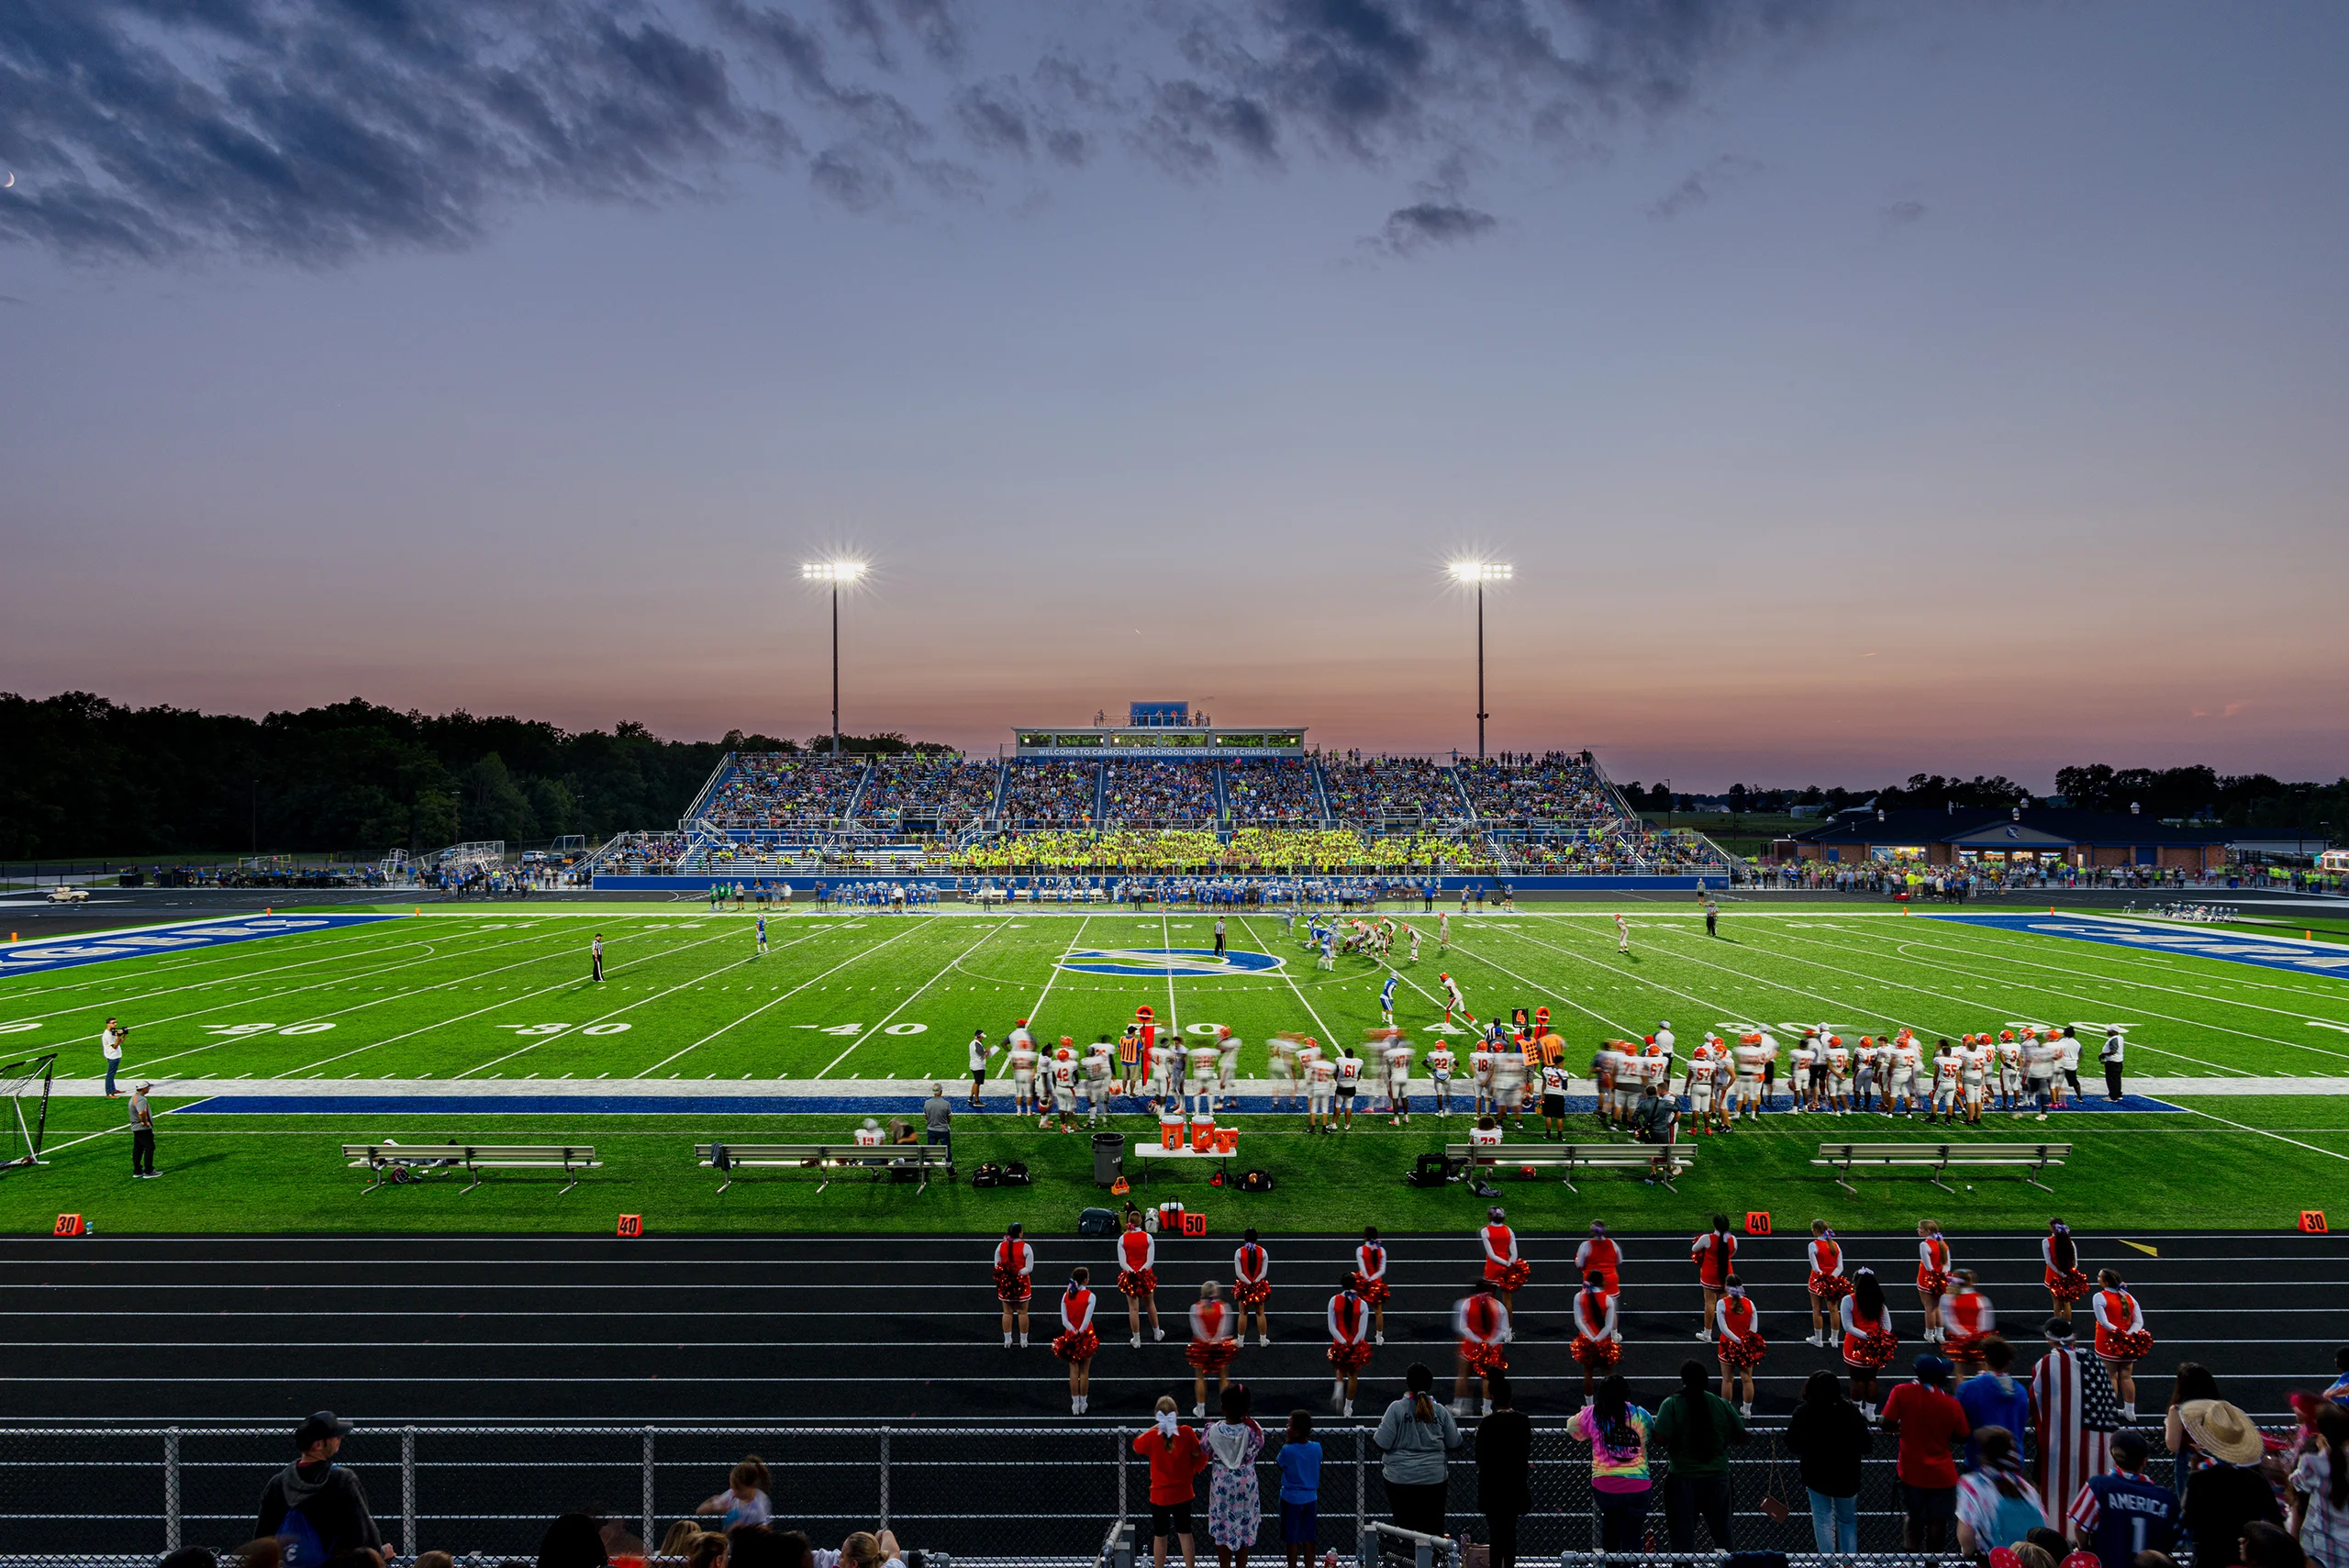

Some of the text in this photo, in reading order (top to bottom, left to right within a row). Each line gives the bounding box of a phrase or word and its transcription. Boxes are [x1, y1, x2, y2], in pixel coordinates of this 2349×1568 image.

[0, 919, 329, 971] GERS
[1516, 1010, 1525, 1024] 4
[516, 1023, 631, 1035] 30
[820, 1023, 928, 1035] 40
[1434, 1058, 1447, 1069] 22
[1478, 1059, 1488, 1072] 18
[1836, 1055, 1845, 1068] 51
[1057, 1068, 1069, 1082] 42
[1344, 1064, 1356, 1078] 61
[1650, 1063, 1664, 1077] 67
[1698, 1068, 1710, 1081] 57
[1943, 1063, 1957, 1077] 55
[1547, 1074, 1561, 1087] 32
[57, 1216, 76, 1233] 30
[620, 1217, 638, 1233] 40
[1186, 1216, 1203, 1233] 50
[1752, 1215, 1768, 1231] 40
[2305, 1214, 2325, 1229] 30
[2110, 1493, 2168, 1518] AMERICA
[2132, 1517, 2146, 1554] 1
